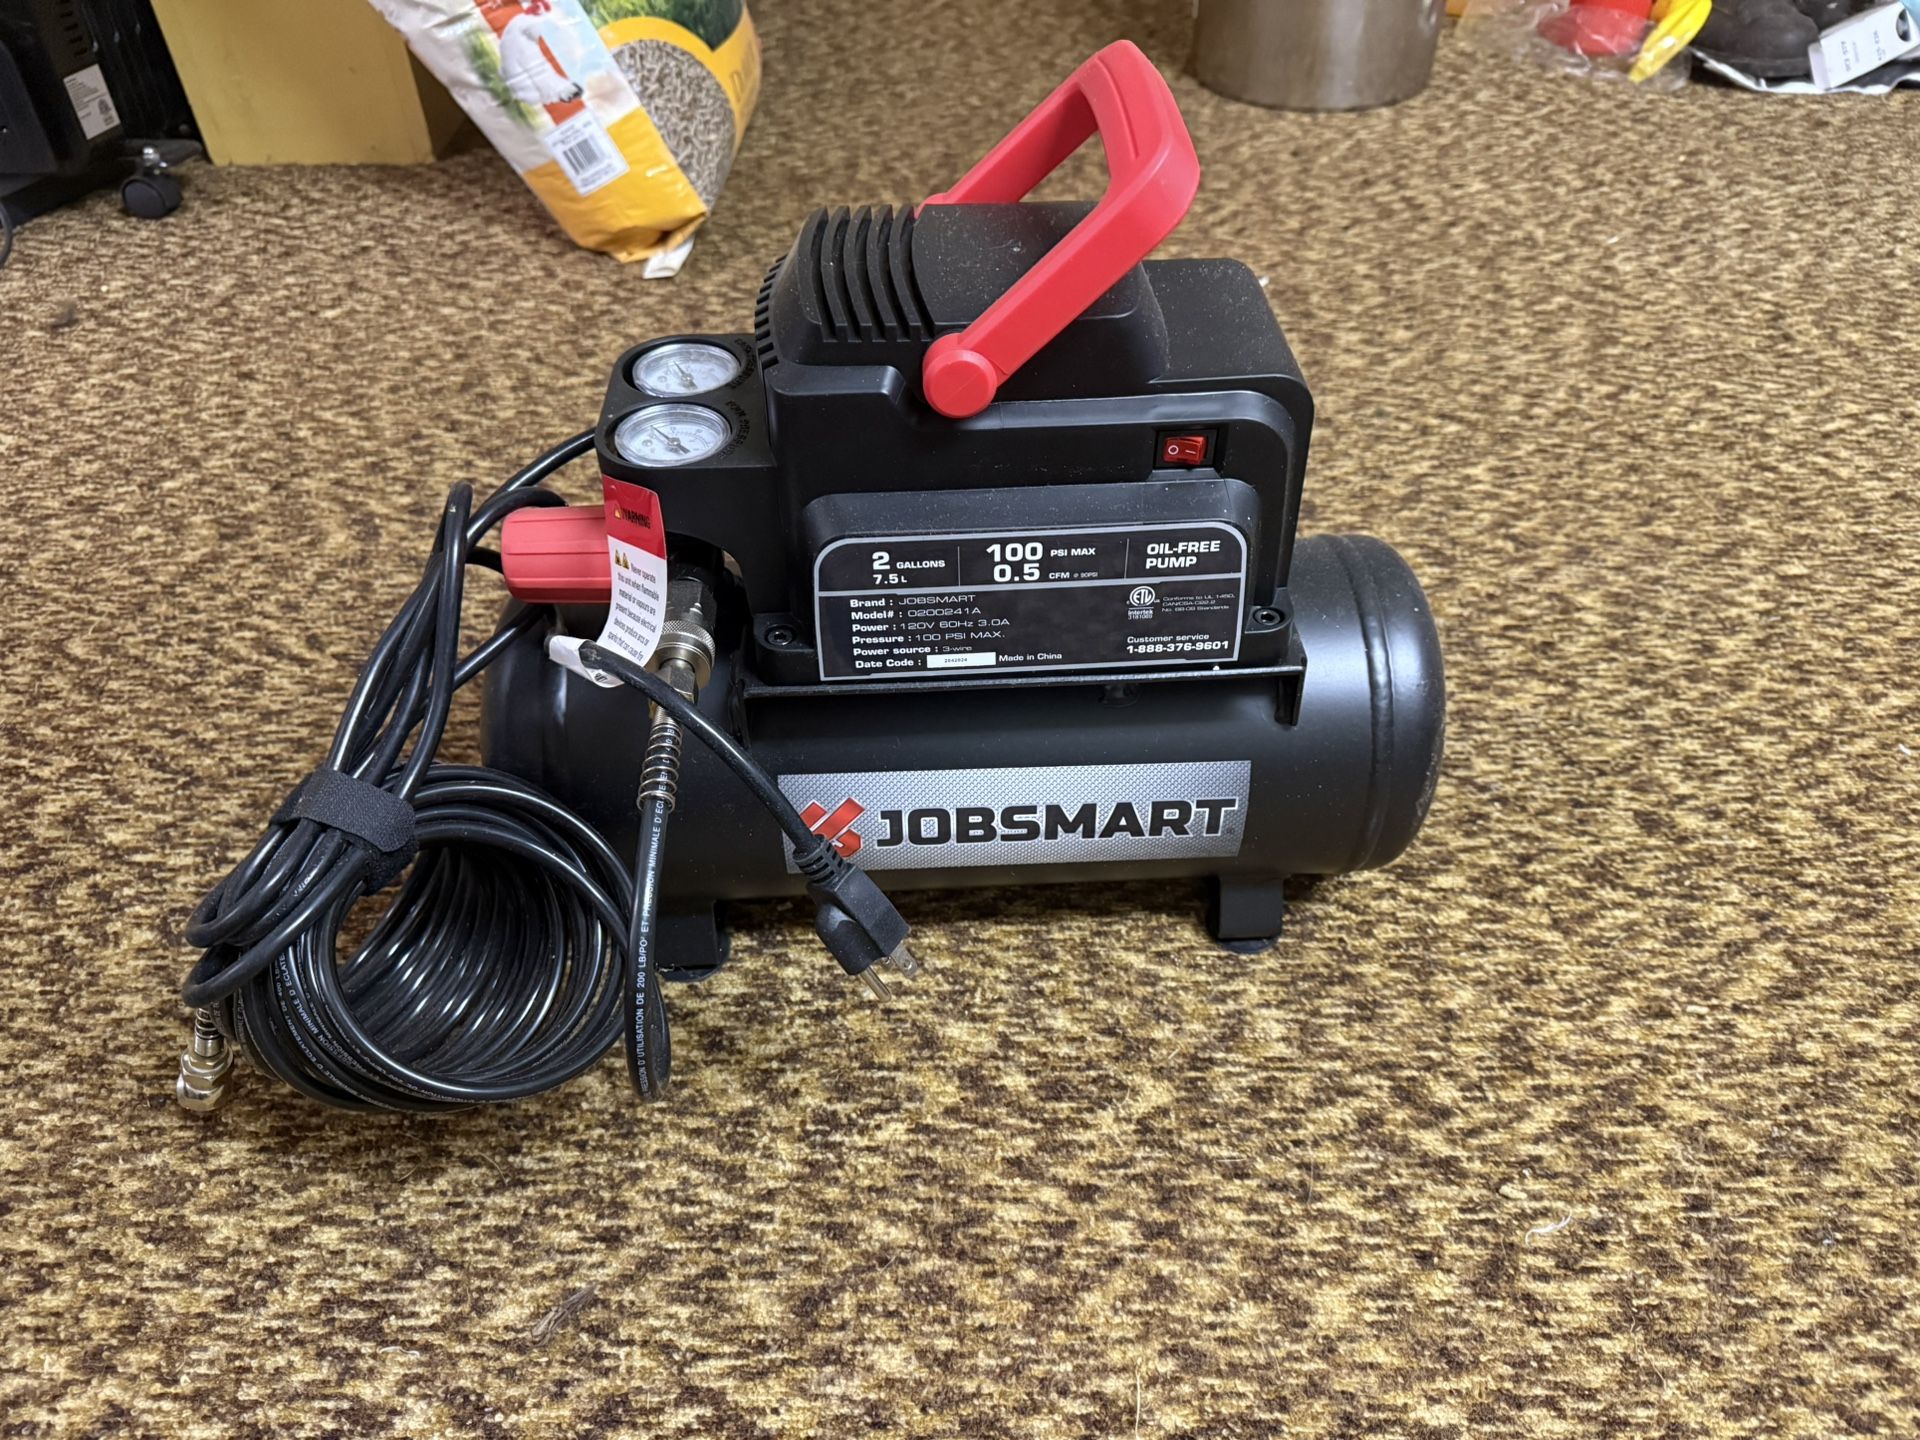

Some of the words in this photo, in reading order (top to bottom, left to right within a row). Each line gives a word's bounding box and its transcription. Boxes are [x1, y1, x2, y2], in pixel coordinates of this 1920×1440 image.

[986, 542, 1043, 562] 100
[1050, 549, 1068, 557] PSI
[1071, 547, 1096, 556] MAX
[1146, 540, 1221, 555] OIL-FREE
[872, 551, 890, 570] 2
[896, 560, 945, 569] GALLONS
[1145, 557, 1198, 570] PUMP
[872, 573, 899, 585] 7.5
[901, 575, 908, 583] L
[993, 563, 1041, 582] 0.5
[850, 599, 885, 608] Brand
[898, 595, 976, 606] JOBSMART
[851, 611, 894, 620] Model#
[907, 607, 981, 618] 0200241A
[852, 623, 889, 632] Power
[900, 621, 935, 630] 120V
[939, 620, 974, 629] 60Hz
[977, 618, 1010, 627] 3.0A
[852, 635, 904, 644] Pressure
[915, 633, 941, 641] 100
[970, 631, 1005, 639] MAX.
[1127, 635, 1174, 643] Customer
[1175, 633, 1209, 641] service
[853, 647, 889, 656] Power
[893, 646, 931, 655] source
[1126, 641, 1229, 654] 1-888-376-9601
[855, 660, 883, 669] Date
[886, 658, 914, 667] Code
[998, 654, 1024, 662] Made
[1026, 653, 1035, 661] in
[1037, 652, 1062, 660] China
[876, 797, 1238, 848] JOBSMART
[648, 826, 661, 868] MINIMALE
[641, 920, 649, 933] ET
[636, 971, 646, 988] 200
[636, 992, 645, 1005] DE
